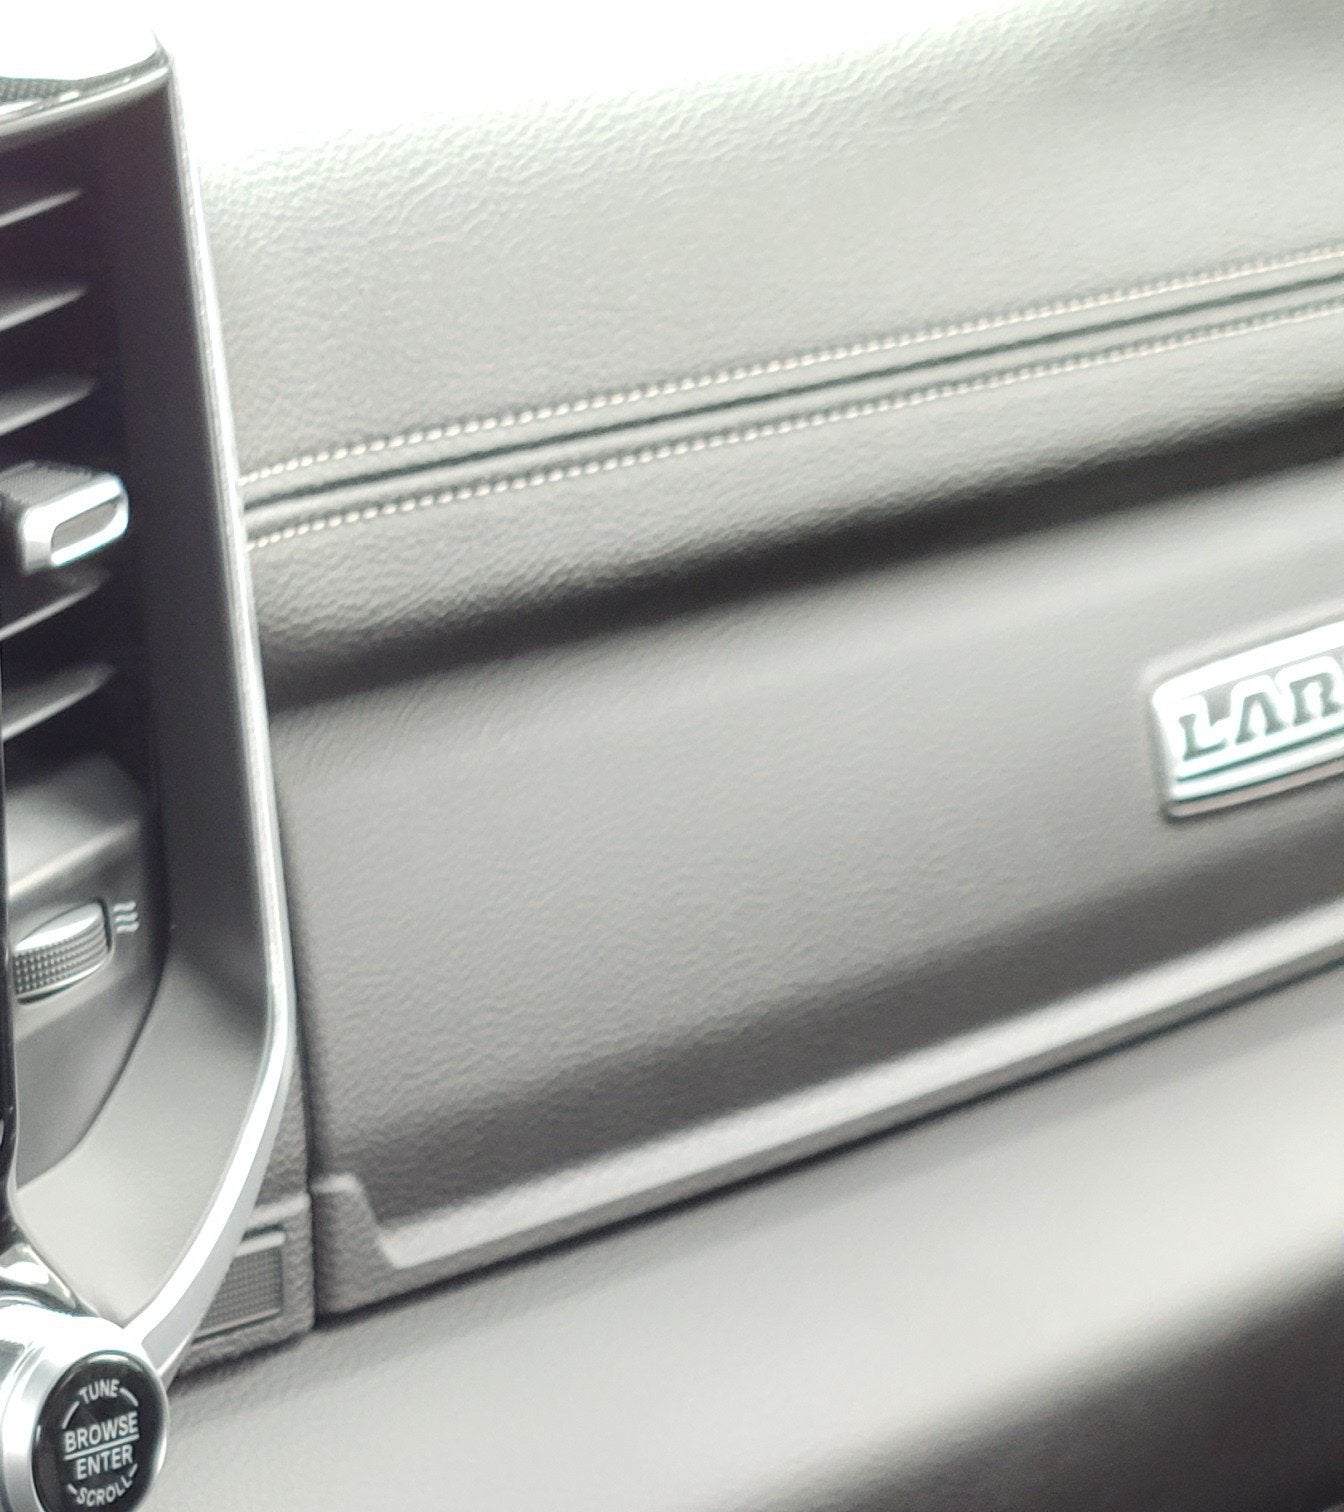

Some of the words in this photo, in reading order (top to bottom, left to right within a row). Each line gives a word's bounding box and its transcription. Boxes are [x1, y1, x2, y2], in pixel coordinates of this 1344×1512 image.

[78, 1379, 121, 1405] TUNE
[64, 1412, 140, 1452] BROWSE
[75, 1445, 134, 1480] ENTER
[75, 1475, 134, 1507] SCROLL
